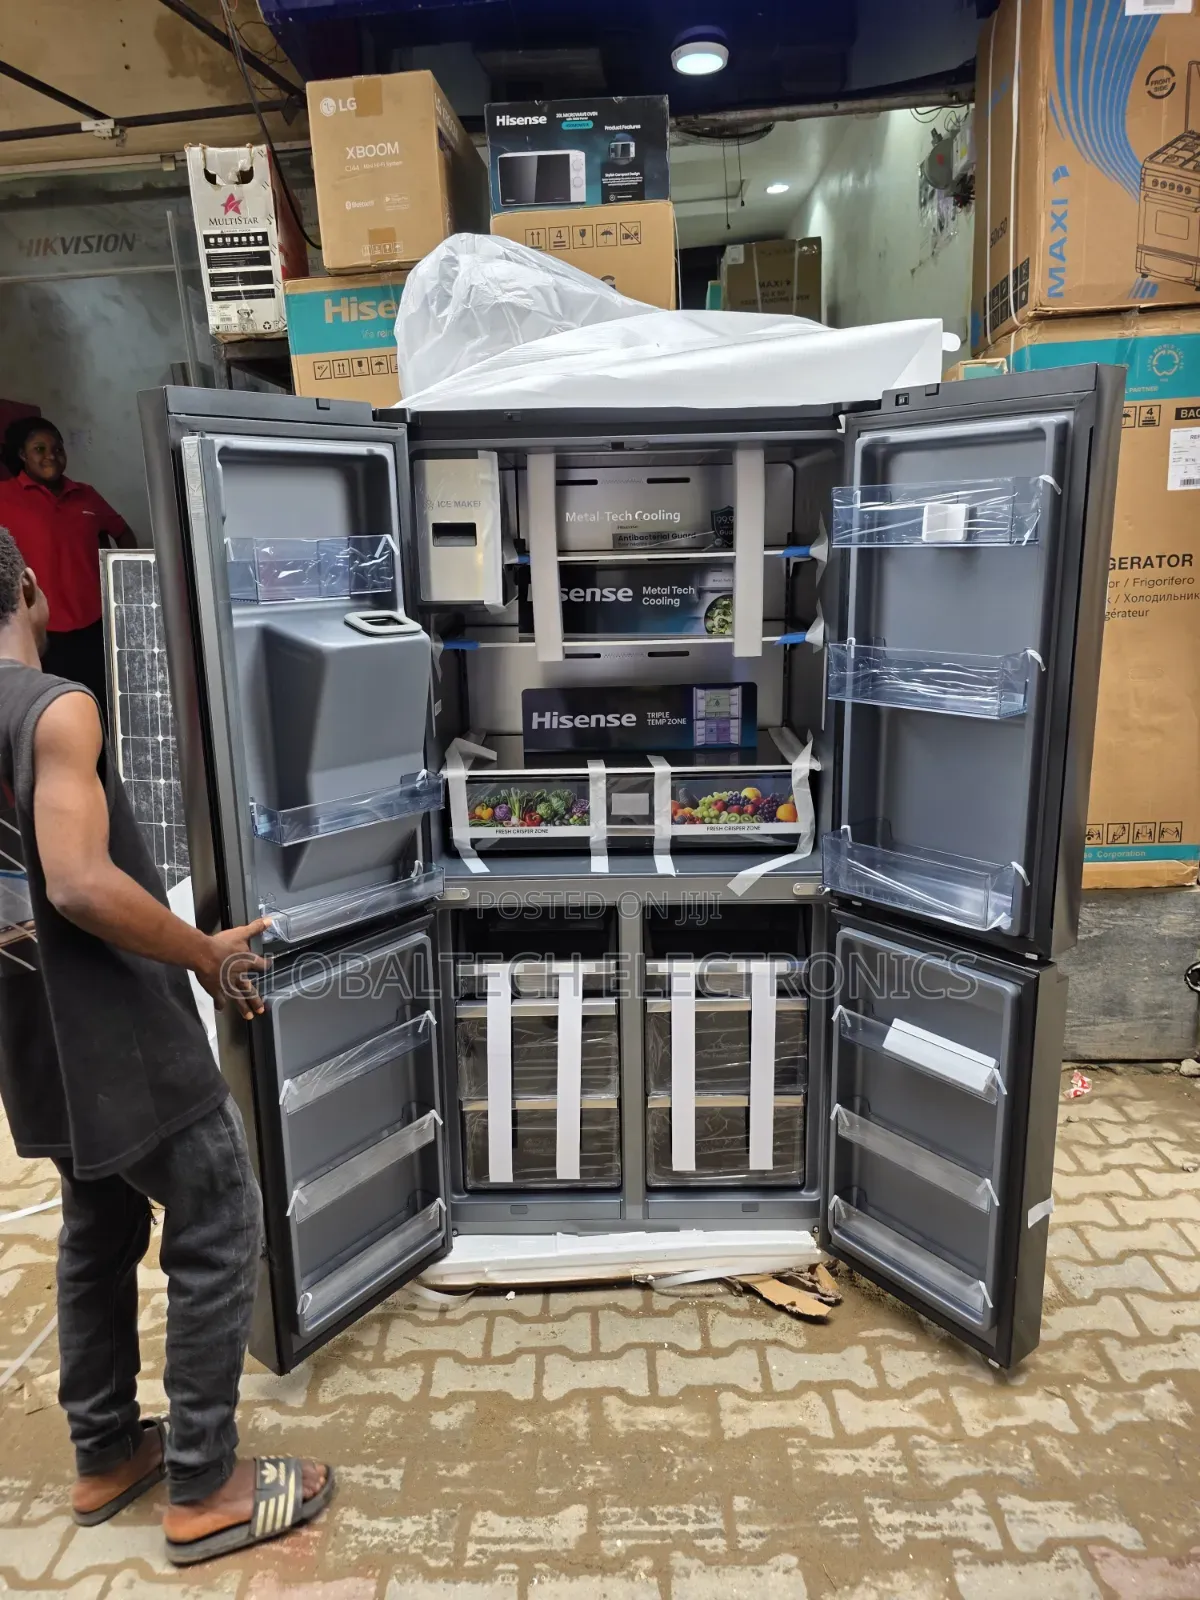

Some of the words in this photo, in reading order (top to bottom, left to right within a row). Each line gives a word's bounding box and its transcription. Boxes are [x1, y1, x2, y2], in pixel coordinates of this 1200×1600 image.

[1150, 77, 1171, 87] FRONT
[338, 97, 357, 112] LG
[496, 115, 547, 127] Hisense
[346, 141, 400, 160] XBOOM
[18, 231, 137, 258] HIKVISION
[1047, 197, 1070, 298] MAXI
[324, 296, 398, 324] Hise
[1180, 408, 1200, 419] BAC
[437, 500, 452, 508] ICE
[634, 509, 681, 523] Cooling
[617, 533, 670, 542] Antibacterial
[1109, 553, 1194, 571] GERATOR
[1132, 576, 1195, 589] Frigorifero
[527, 583, 633, 602] sense
[642, 585, 670, 595] Metal
[671, 585, 695, 595] Tech
[642, 596, 680, 608] Cooling
[1123, 592, 1200, 604] Холодильник
[1104, 607, 1150, 622] gérateur
[531, 711, 637, 730] Hisense
[646, 711, 670, 719] TRIPLE
[646, 718, 667, 726] TEMP
[667, 717, 687, 725] ZONE
[1096, 850, 1146, 860] Corporation
